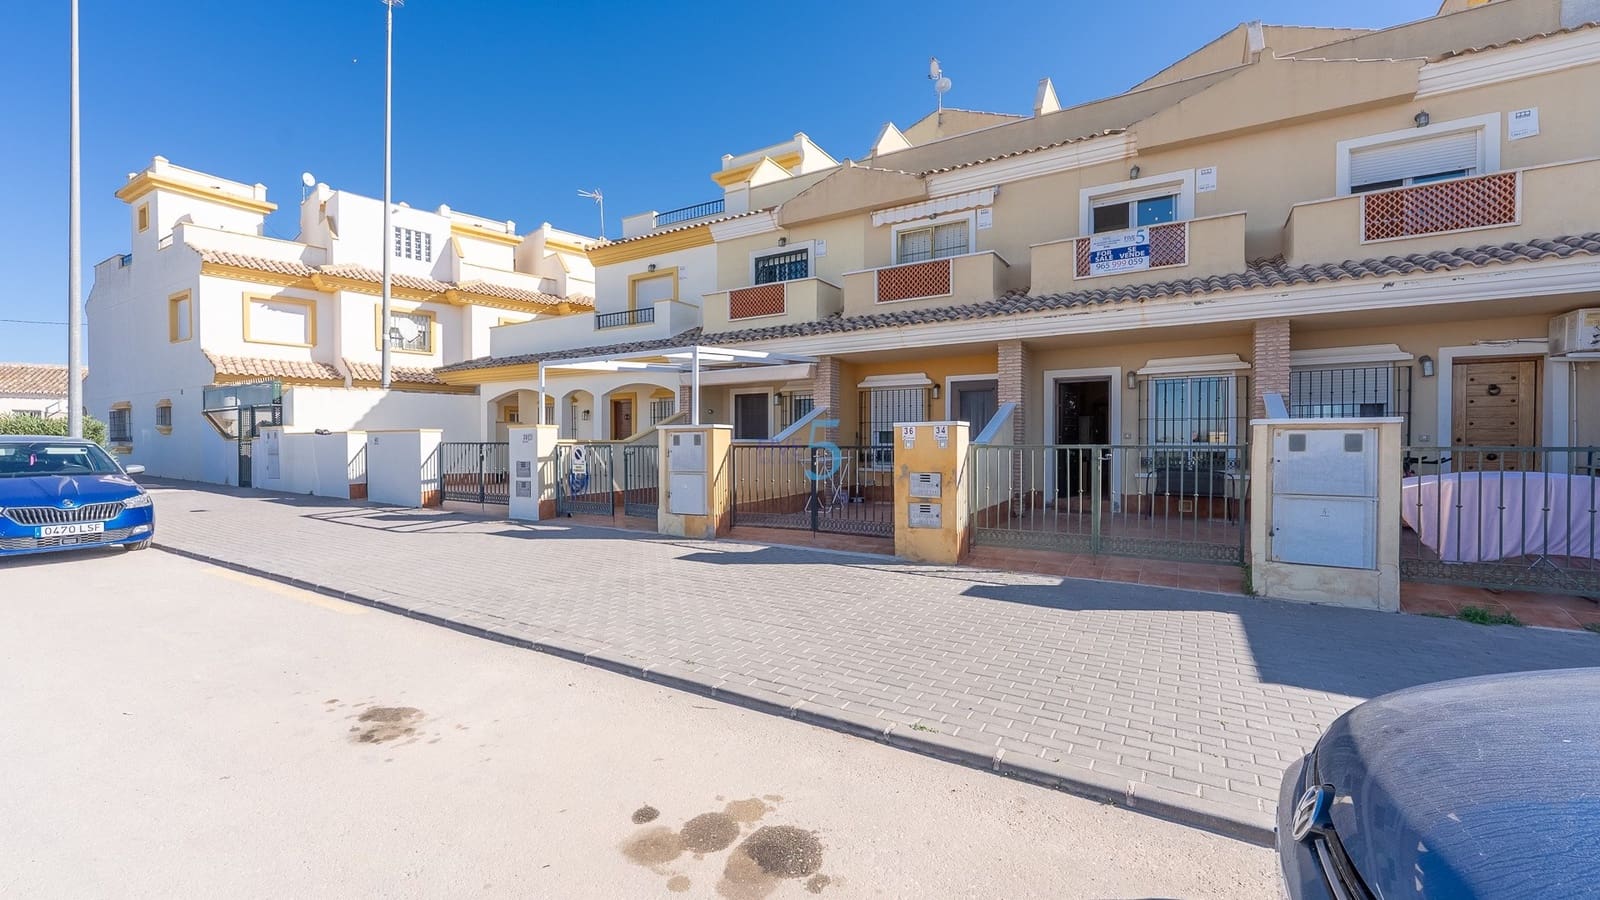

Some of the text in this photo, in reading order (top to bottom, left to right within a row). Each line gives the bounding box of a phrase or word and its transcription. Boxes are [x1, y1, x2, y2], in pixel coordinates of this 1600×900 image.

[1136, 229, 1145, 244] 5
[1096, 249, 1112, 257] FOR
[1119, 250, 1145, 259] VENDE
[1095, 255, 1113, 263] SALE
[1095, 262, 1110, 270] 965
[1112, 260, 1127, 269] 999
[1128, 258, 1144, 266] 059
[903, 427, 914, 435] 36
[935, 426, 946, 434] 34
[44, 523, 102, 536] 0470 LSF
